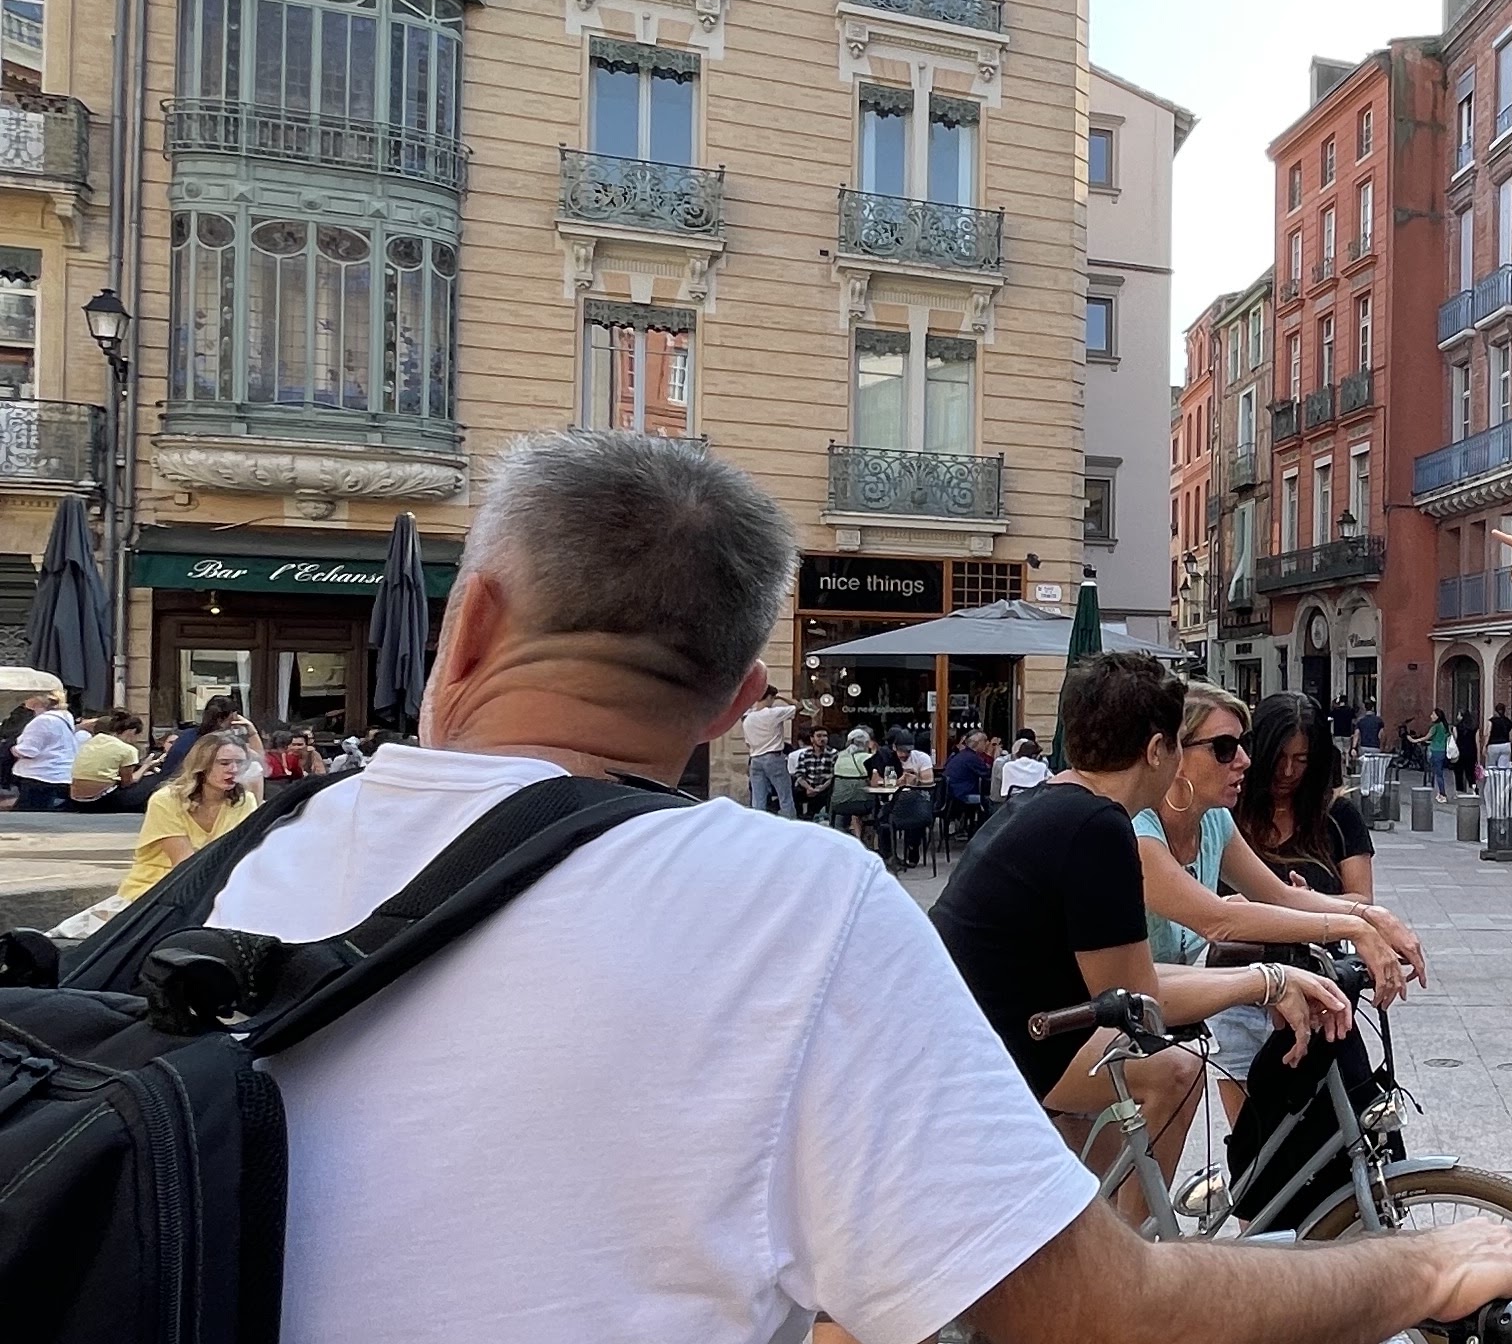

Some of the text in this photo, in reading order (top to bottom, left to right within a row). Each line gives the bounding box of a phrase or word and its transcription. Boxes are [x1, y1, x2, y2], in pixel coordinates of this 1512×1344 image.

[187, 559, 248, 579] Bar
[820, 573, 925, 596] nice things
